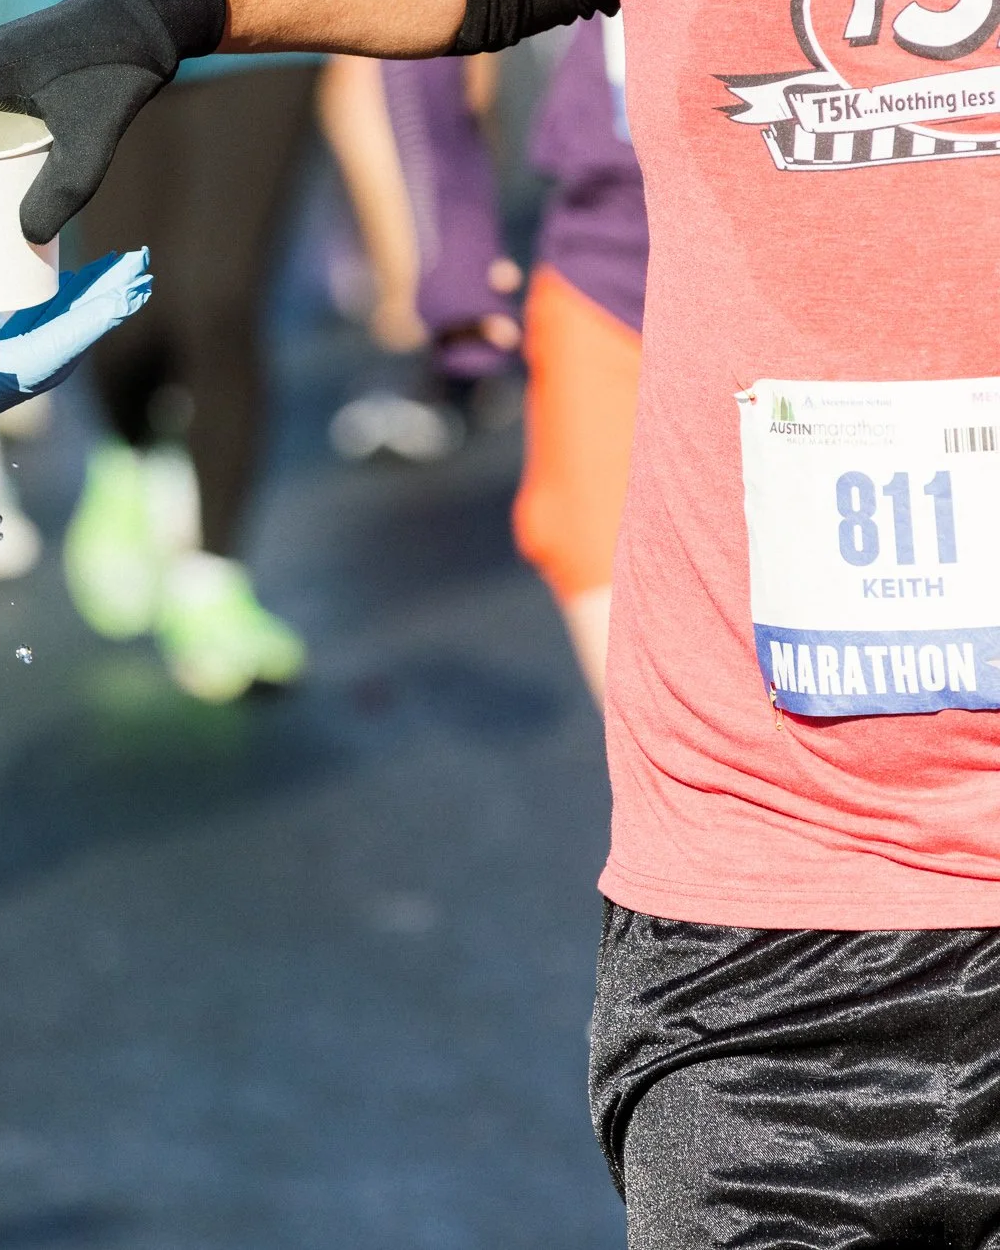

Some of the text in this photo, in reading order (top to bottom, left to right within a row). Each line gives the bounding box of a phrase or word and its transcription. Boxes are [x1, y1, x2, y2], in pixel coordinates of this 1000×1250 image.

[962, 90, 996, 108] less
[836, 470, 958, 567] 811
[863, 577, 945, 599] KEITH
[770, 640, 977, 696] MARATHON
